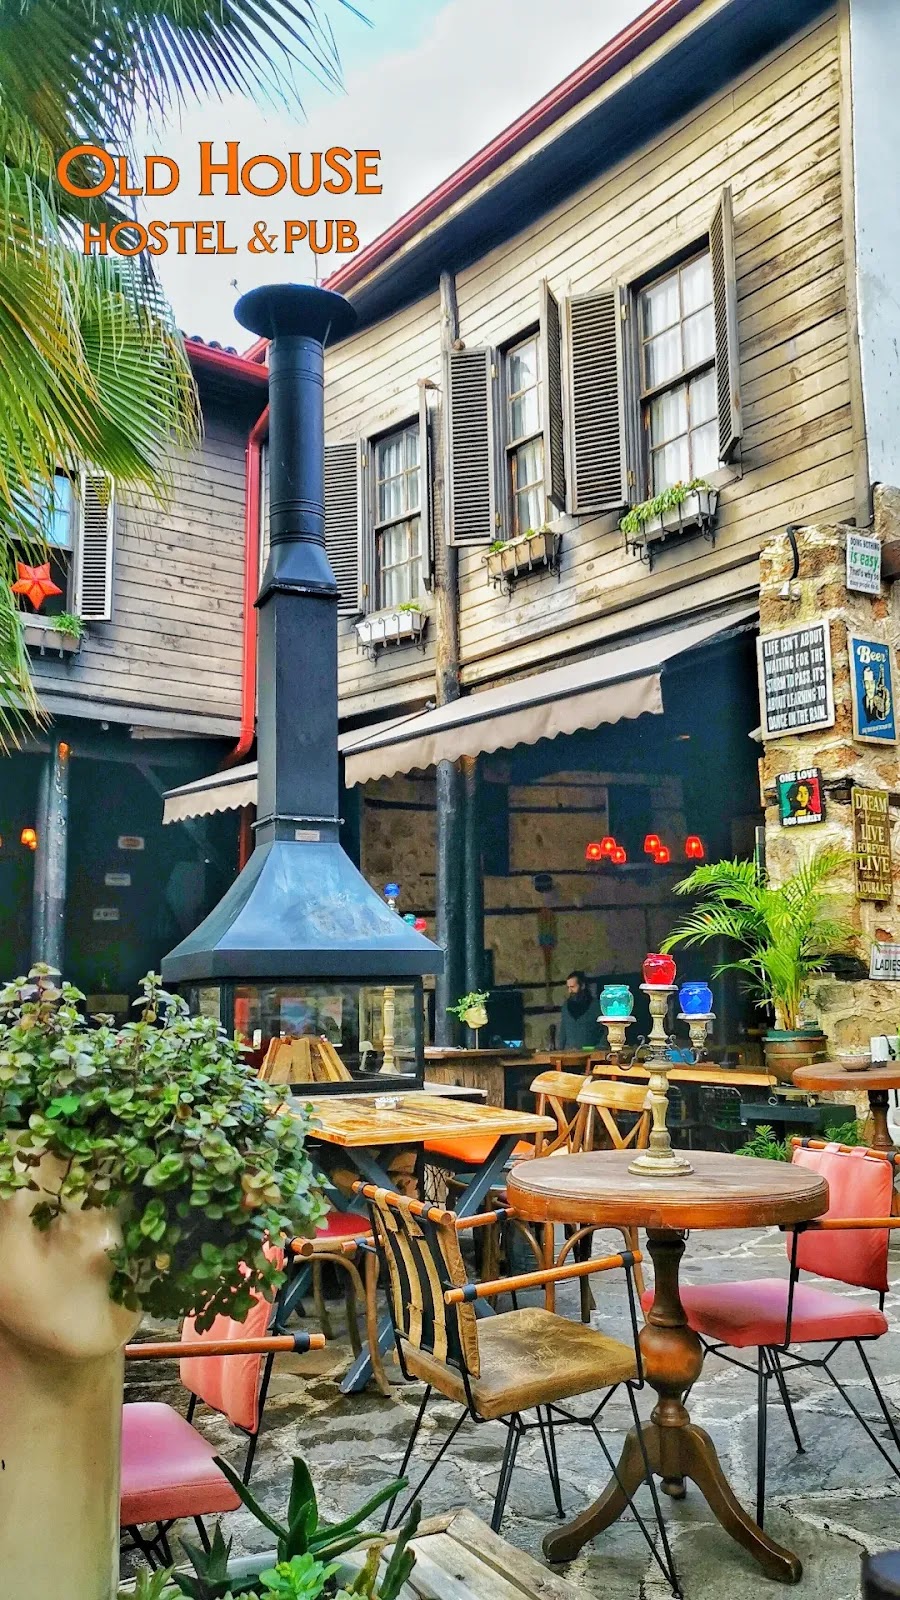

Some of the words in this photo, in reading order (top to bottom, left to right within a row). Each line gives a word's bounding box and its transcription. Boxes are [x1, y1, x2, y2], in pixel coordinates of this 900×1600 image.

[764, 640, 780, 657] LIFE
[780, 635, 799, 652] ISN'T
[800, 628, 823, 648] ABOUT
[765, 655, 795, 675] WAITING
[795, 651, 809, 668] FOR
[810, 647, 825, 664] THE
[857, 645, 887, 664] Beer
[766, 675, 787, 693] STORM
[786, 673, 795, 689] TO
[812, 666, 825, 682] IT'S
[767, 694, 787, 712] ABOUT
[787, 687, 817, 708] LEARNING
[817, 684, 826, 700] TO
[768, 713, 788, 731] DANCE
[788, 711, 796, 726] IN
[797, 708, 809, 724] THE
[809, 704, 828, 722] RAIN.
[779, 772, 796, 783] ONE
[797, 768, 818, 780] LOVE
[855, 793, 887, 813] DREAM
[782, 816, 797, 826] BOB
[861, 824, 885, 842] LIVE
[857, 842, 890, 856] FOREVER
[859, 855, 890, 873] LIVE
[874, 959, 900, 972] LADIES
